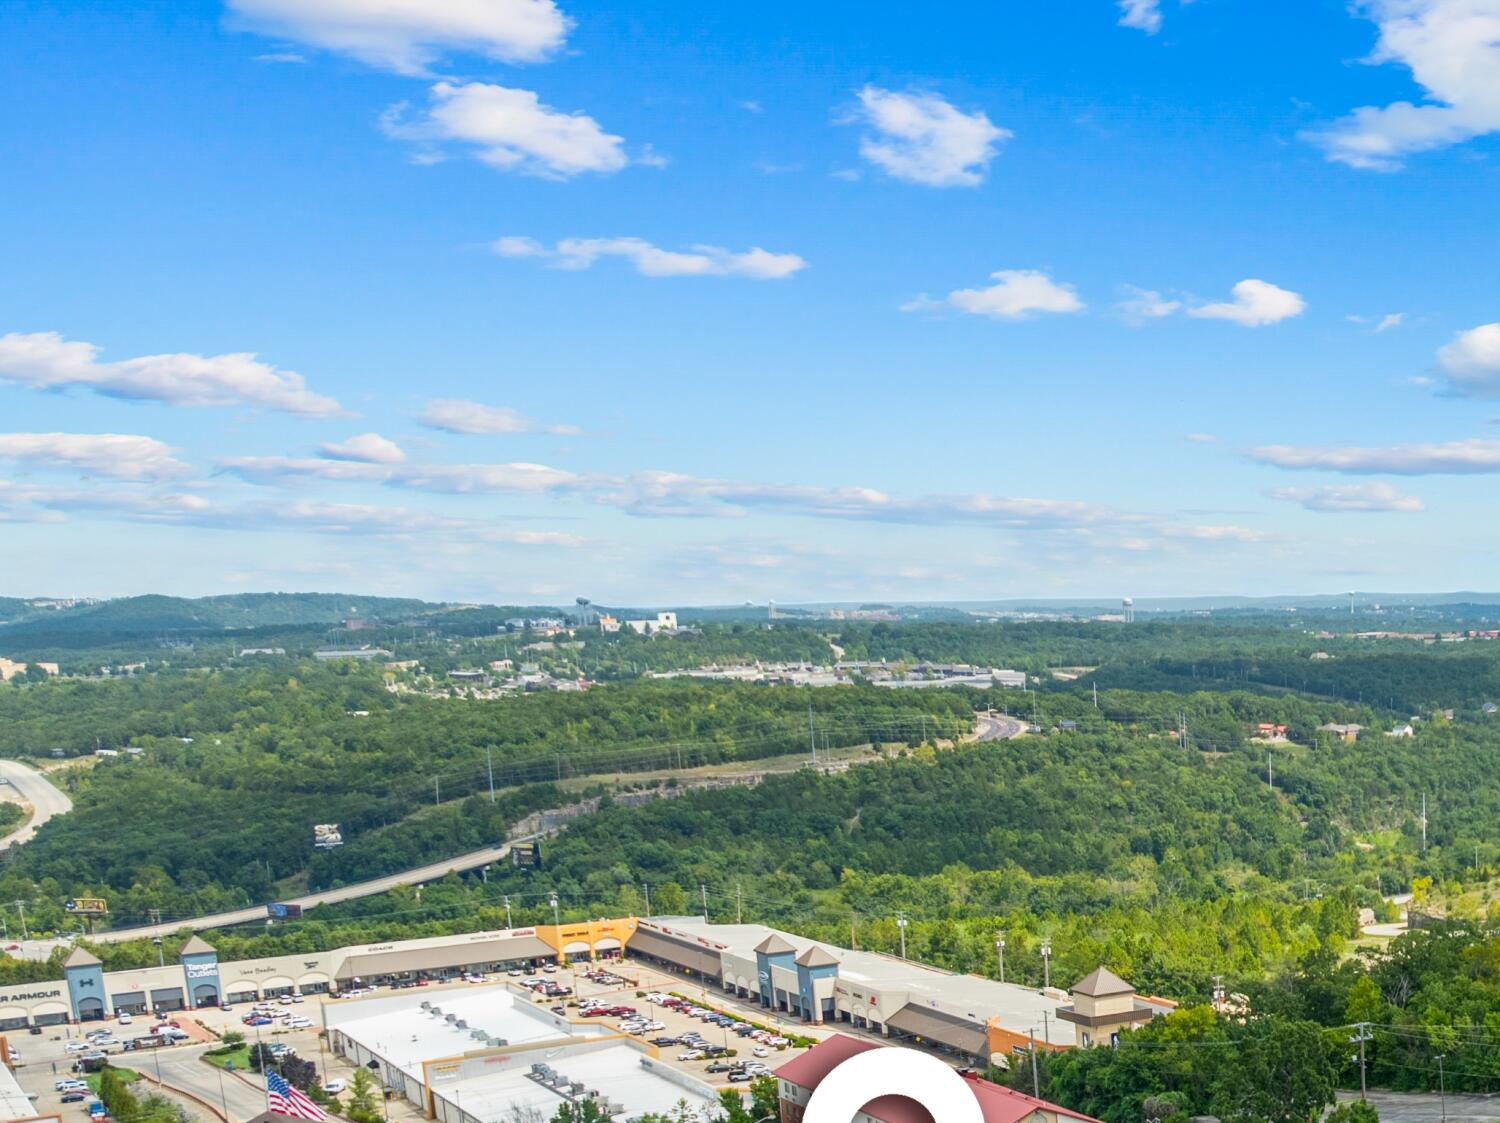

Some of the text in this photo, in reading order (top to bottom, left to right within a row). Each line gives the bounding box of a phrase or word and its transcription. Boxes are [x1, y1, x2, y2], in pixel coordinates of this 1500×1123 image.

[187, 963, 217, 971] Tanger
[187, 969, 218, 978] Outlets
[11, 990, 61, 1001] ARMOUR
